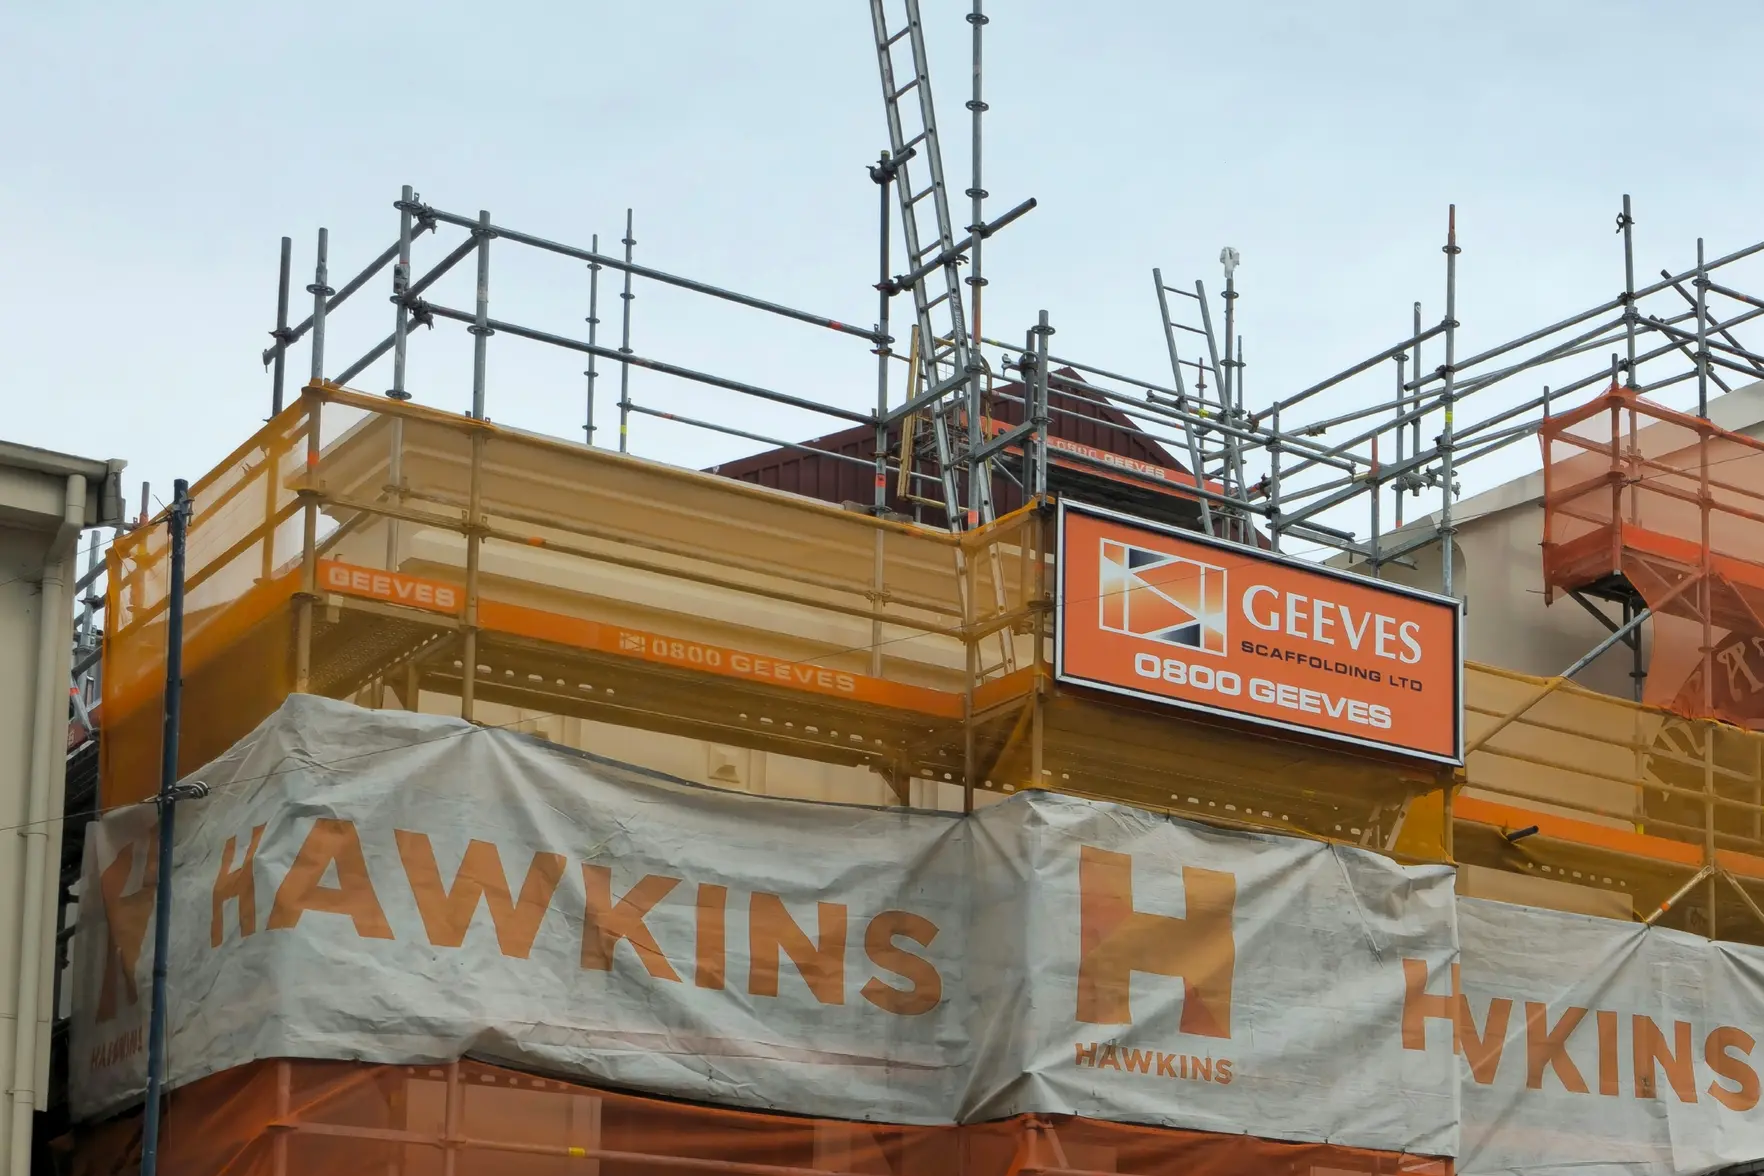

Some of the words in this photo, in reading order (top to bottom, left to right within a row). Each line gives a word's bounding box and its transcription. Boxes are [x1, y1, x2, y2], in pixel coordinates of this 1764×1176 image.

[1103, 453, 1165, 479] GEEVES
[327, 565, 457, 609] GEEVES
[1241, 583, 1422, 665] GEEVES
[650, 639, 722, 671] 0800
[729, 654, 855, 693] GEEVES
[1133, 651, 1241, 697] 0800
[1248, 677, 1393, 730] GEEVES
[1240, 640, 1382, 684] SCAFFOLDING
[1388, 673, 1424, 693] LTD
[211, 818, 943, 1016] HAWKINS
[1076, 845, 1237, 1040] H
[1074, 1042, 1234, 1086] HAWKINS
[1402, 957, 1762, 1112] HWKINS
